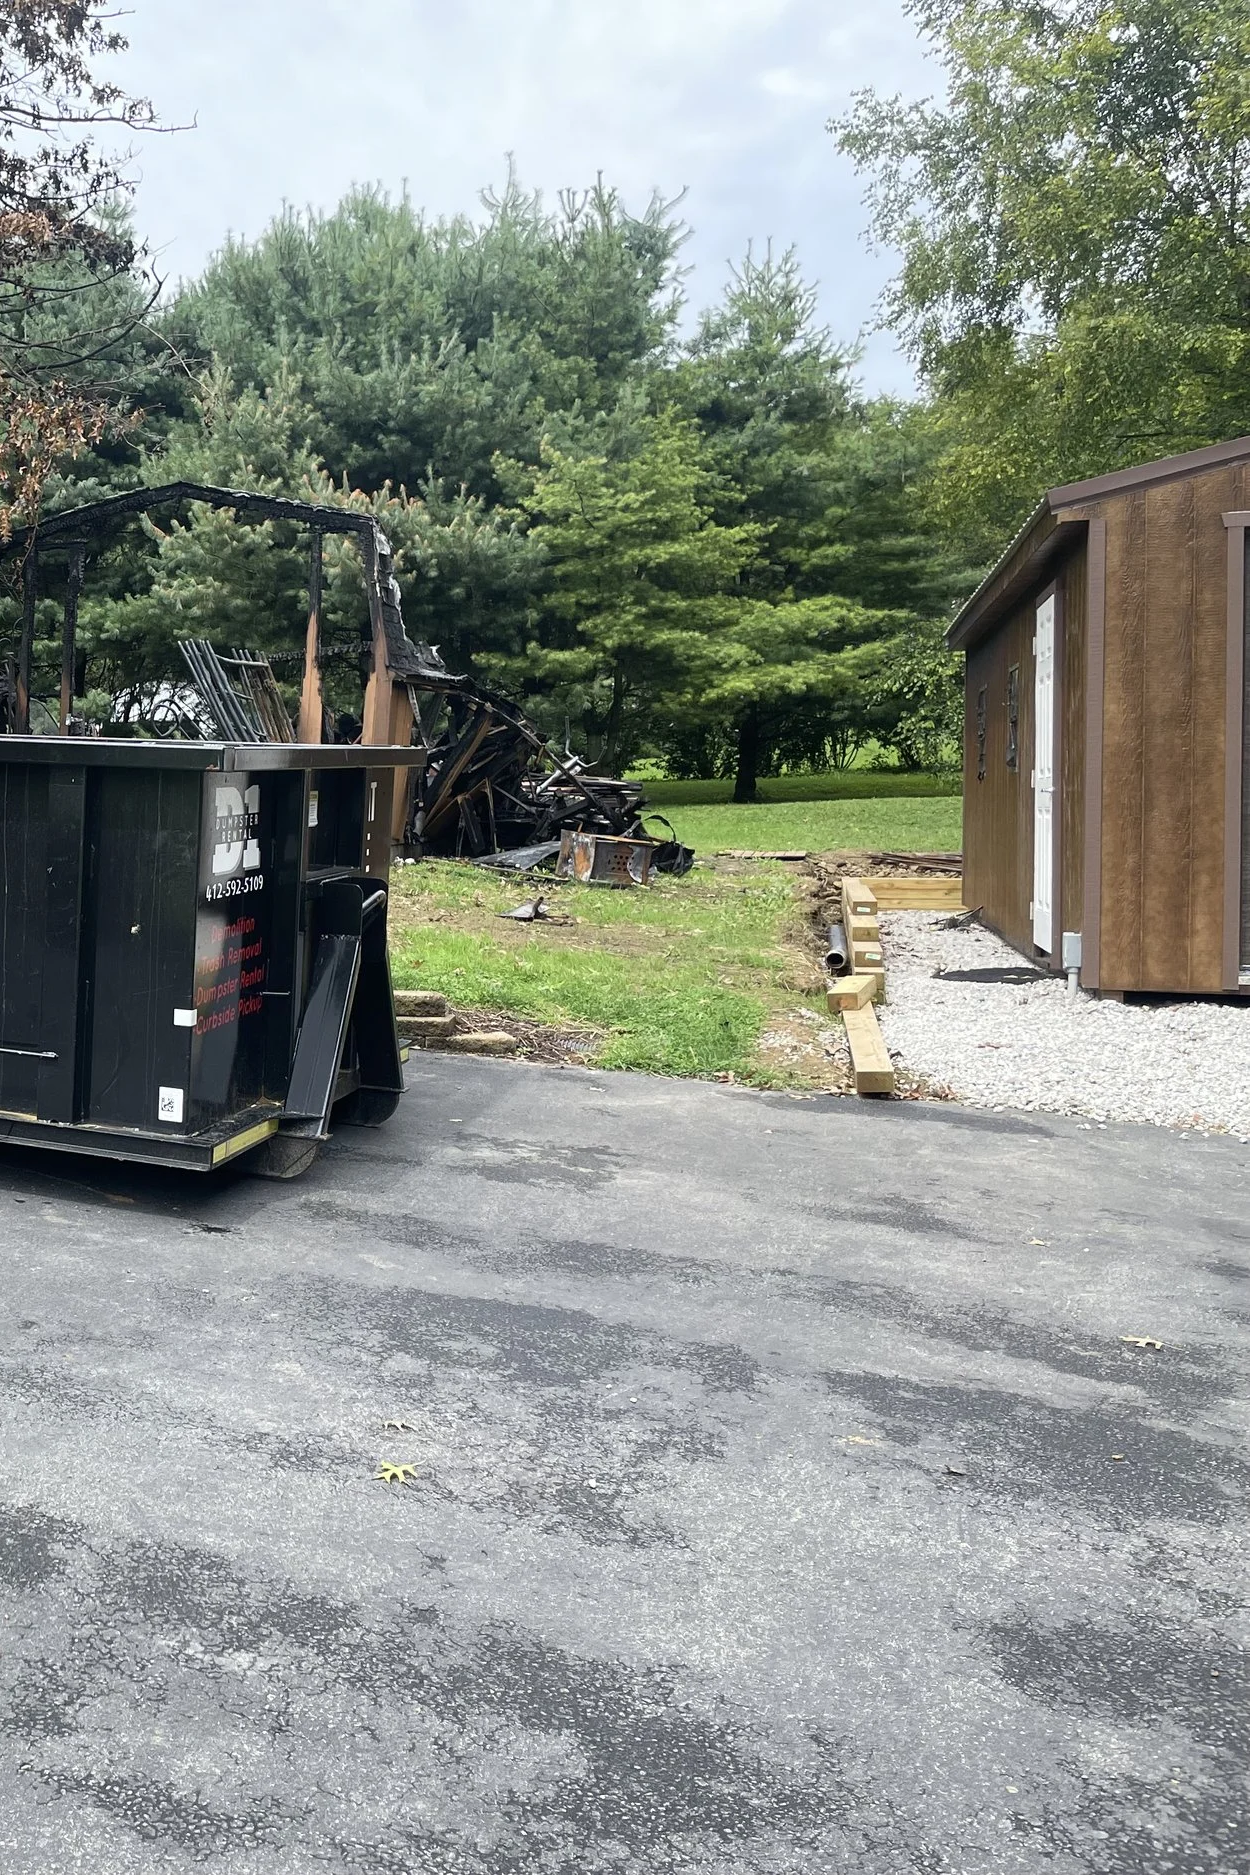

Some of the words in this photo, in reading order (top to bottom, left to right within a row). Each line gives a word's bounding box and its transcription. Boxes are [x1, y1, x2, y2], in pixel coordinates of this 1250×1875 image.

[212, 784, 261, 876] D1
[215, 814, 259, 830] DUMPSTER
[221, 828, 252, 842] RENTAL
[206, 874, 264, 902] 412-592-5109
[211, 916, 255, 943] Demolition
[202, 953, 225, 977] Trash
[227, 938, 263, 968] Removal
[196, 978, 238, 1007] Dumpster
[239, 963, 265, 990] Rental
[195, 1005, 236, 1036] Curbside
[238, 995, 263, 1020] Pickup
